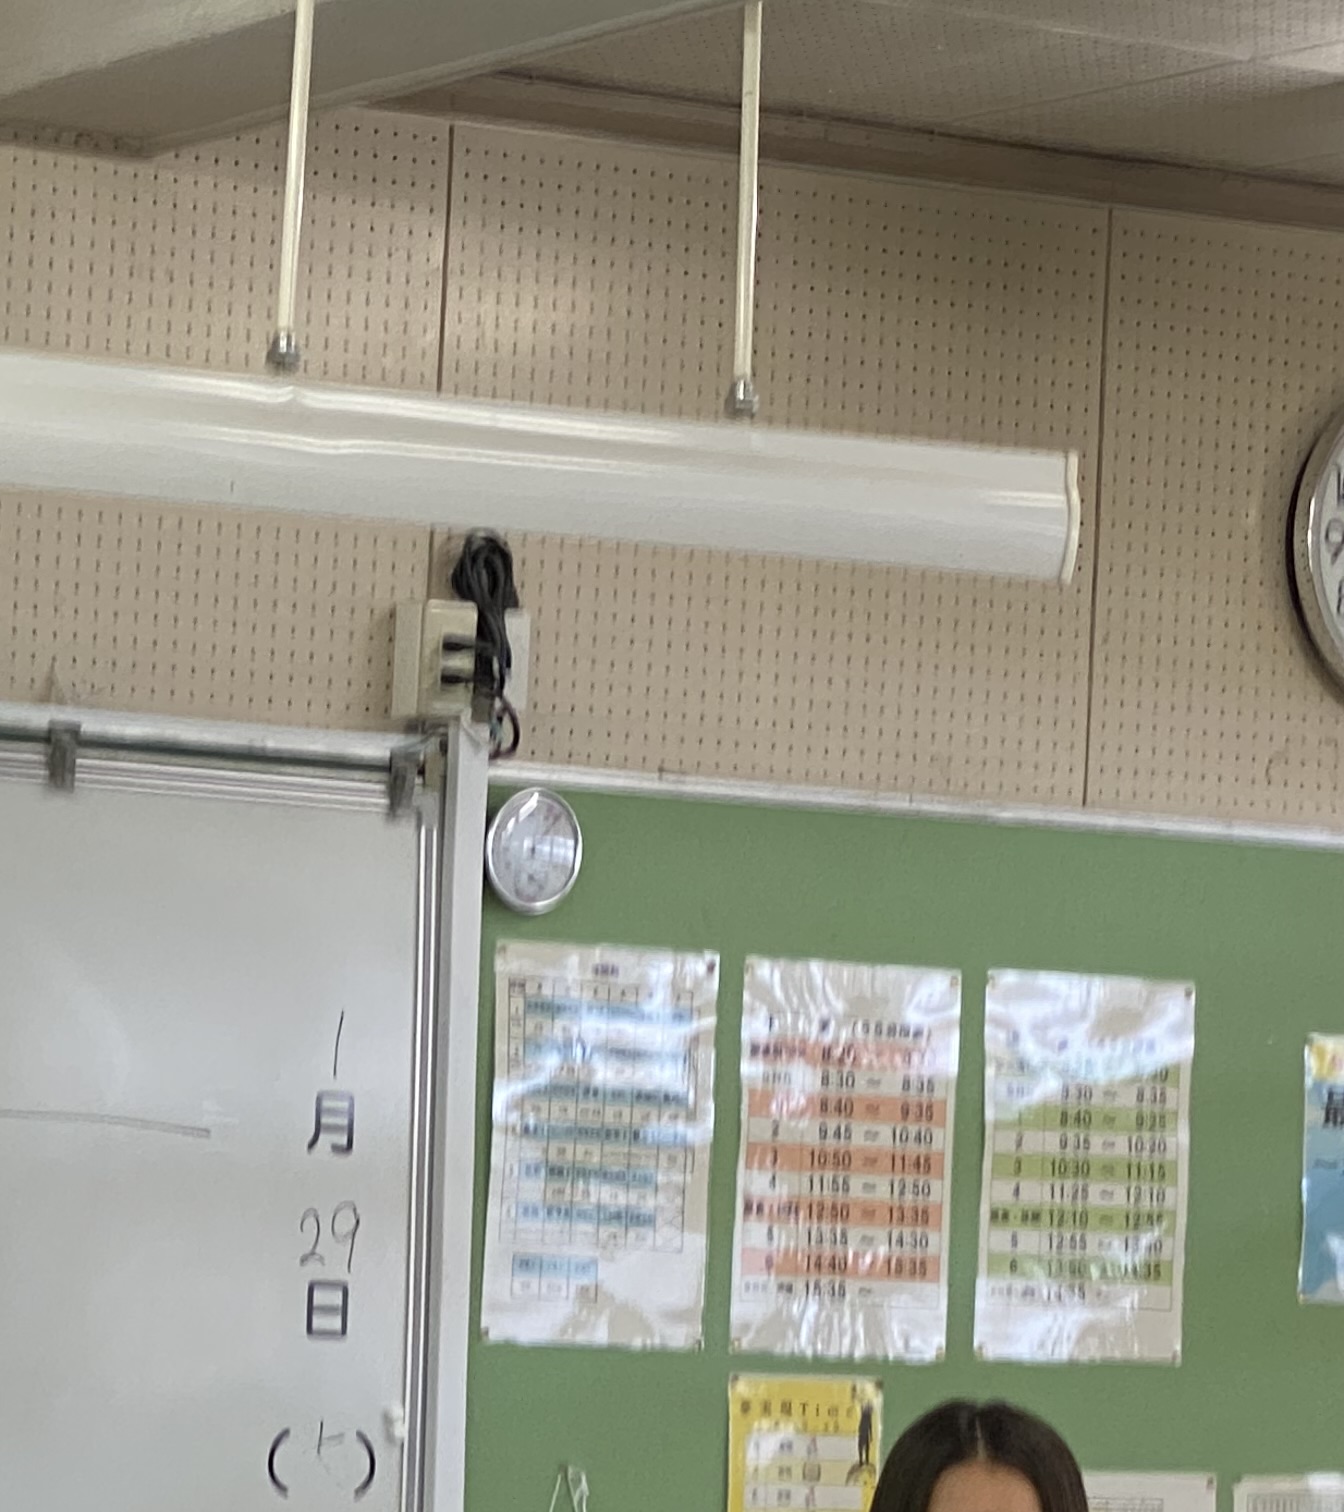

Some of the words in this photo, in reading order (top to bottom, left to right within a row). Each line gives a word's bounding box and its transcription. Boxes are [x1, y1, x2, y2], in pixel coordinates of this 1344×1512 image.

[820, 1096, 854, 1117] 8:40
[892, 1126, 933, 1146] 10:40
[809, 1150, 852, 1168] 10:50
[891, 1153, 931, 1174] 11:45
[1127, 1161, 1166, 1180] 11:15
[808, 1174, 851, 1193] 11:55
[889, 1179, 931, 1197] 12:50
